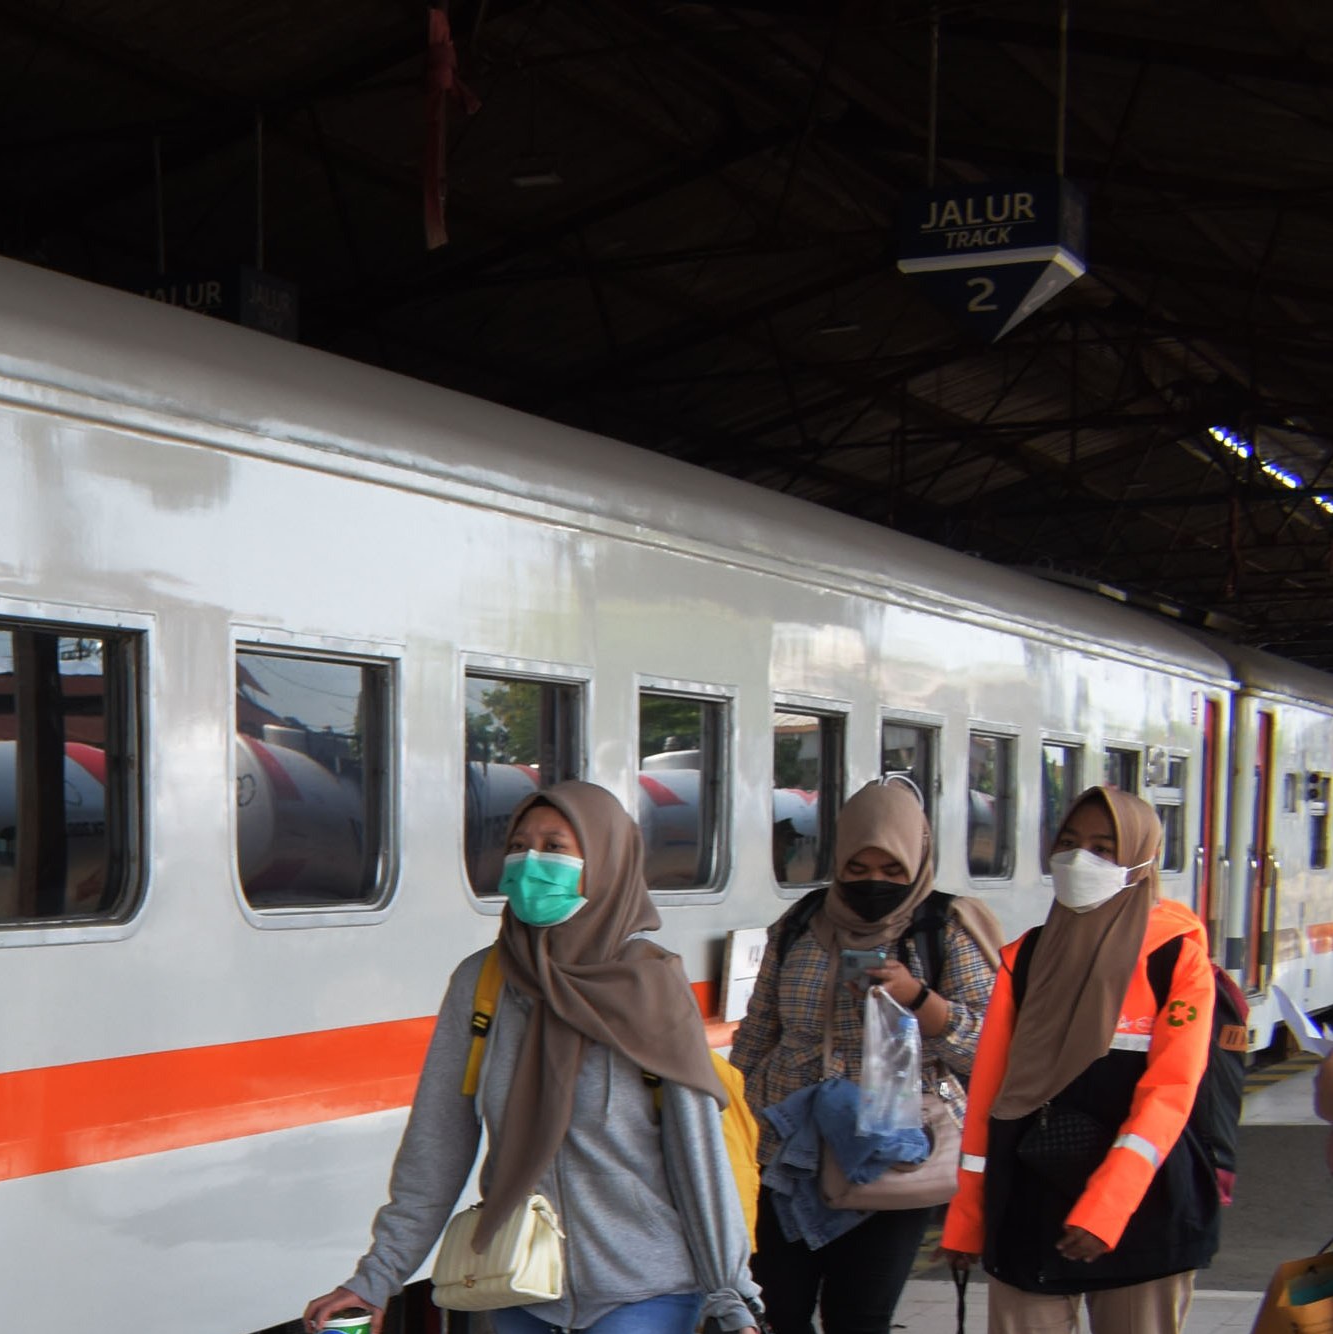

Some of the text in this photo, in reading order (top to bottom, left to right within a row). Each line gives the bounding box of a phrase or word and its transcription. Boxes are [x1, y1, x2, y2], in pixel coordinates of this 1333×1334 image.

[920, 192, 1036, 230] JALUR
[944, 226, 1013, 249] TRACK
[965, 276, 999, 312] 2
